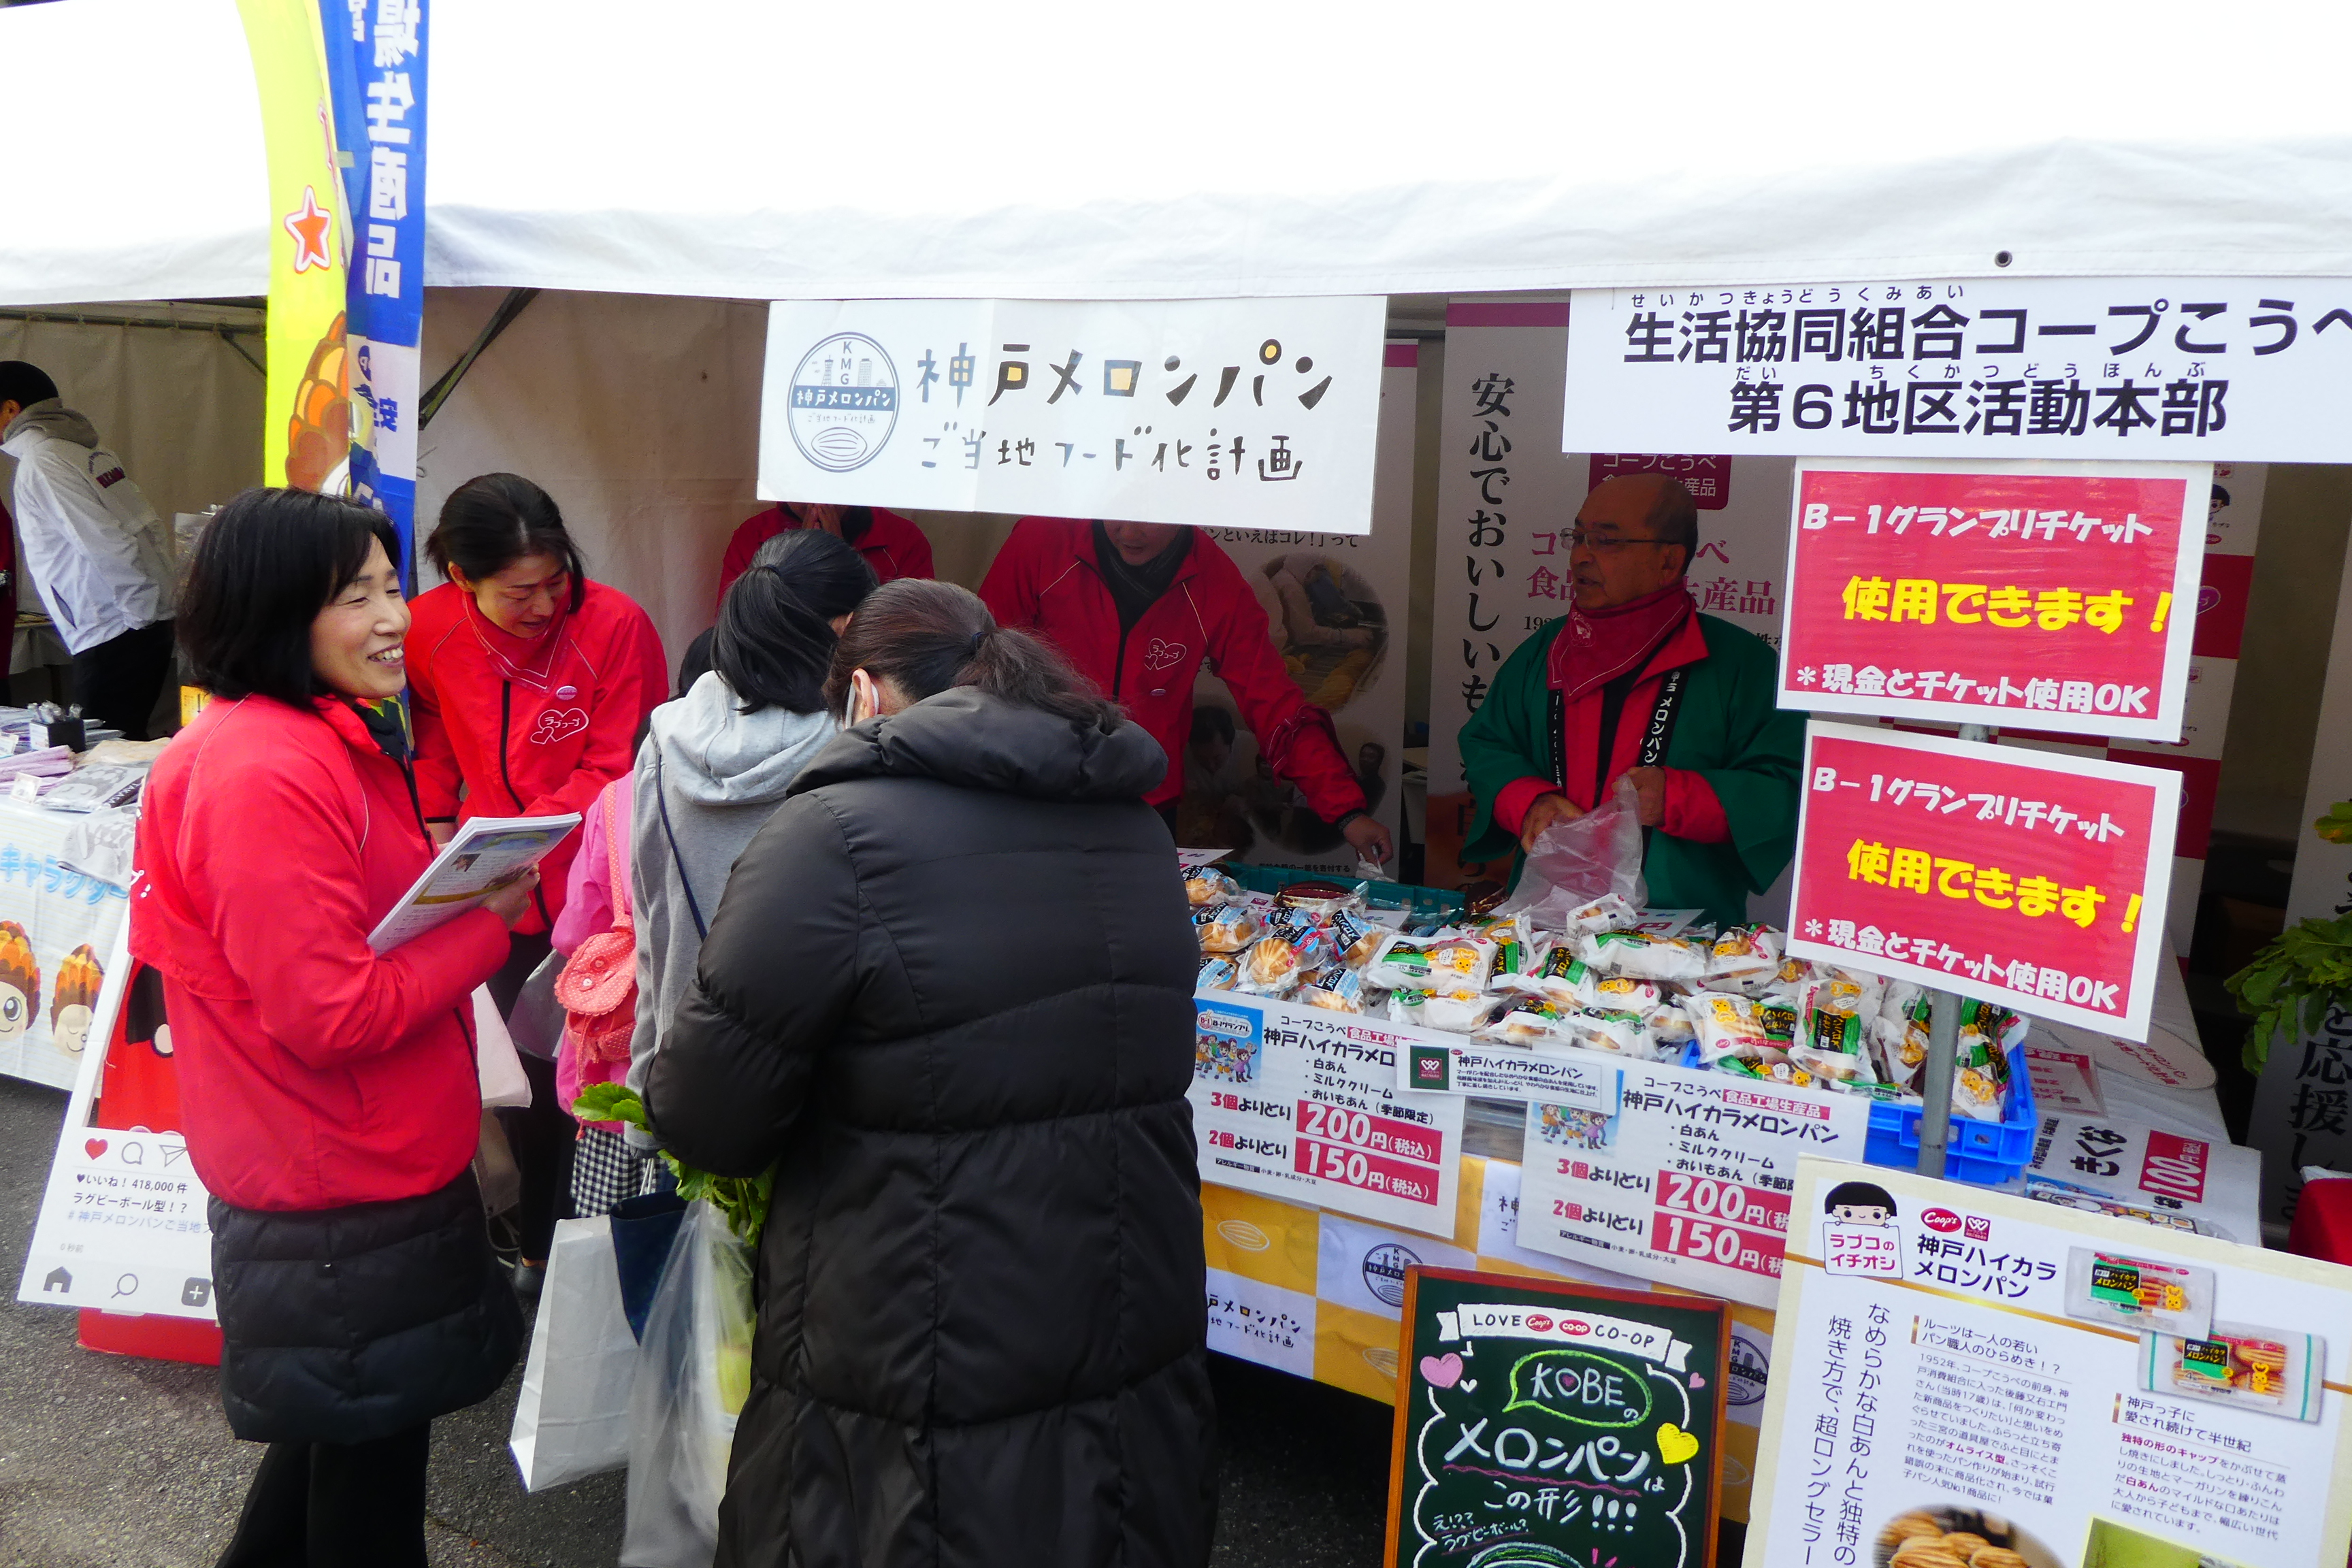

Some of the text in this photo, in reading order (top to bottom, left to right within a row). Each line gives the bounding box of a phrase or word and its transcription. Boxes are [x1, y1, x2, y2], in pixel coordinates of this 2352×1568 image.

[916, 339, 1333, 410] 神戸メロンパン
[1737, 367, 1778, 382] だい
[796, 389, 891, 407] 神戸メロンパン
[1727, 379, 2229, 438] 第6地区活動本部
[920, 421, 1303, 483] ご当地フード化計画
[1841, 574, 2173, 634] 使用できます！
[1846, 837, 2143, 934] 使用できます！
[1280, 1015, 1347, 1035] コープこうべ
[1457, 1056, 1584, 1079] 神戸ハイカラメロンパン
[1210, 1091, 1292, 1121] 3個よりどり
[1644, 1076, 1821, 1119] コープこうべ 食品工場生産品
[1622, 1088, 1840, 1145] 神戸ハイカラメロンパン
[1209, 1129, 1288, 1159] 2個よりどり
[131, 1179, 174, 1194] 418,000
[1556, 1158, 1650, 1194] 3個よりどり
[1552, 1198, 1644, 1236] 2個よりどり
[1829, 1233, 1895, 1251] ラブコの
[1916, 1232, 2057, 1281] 神戸ハイカラ
[1830, 1253, 1895, 1271] イチオシ
[1913, 1260, 2029, 1298] メロンパン
[1473, 1311, 1521, 1327] LOVE
[1595, 1324, 1655, 1348] CO-OP
[1923, 1318, 2039, 1355] ルーツは一人の若い
[2127, 1395, 2195, 1422] 神戸っ子に
[1833, 1302, 1891, 1566] なめらかな白あんと独特の
[2123, 1409, 2252, 1454] 愛され続けて半世紀
